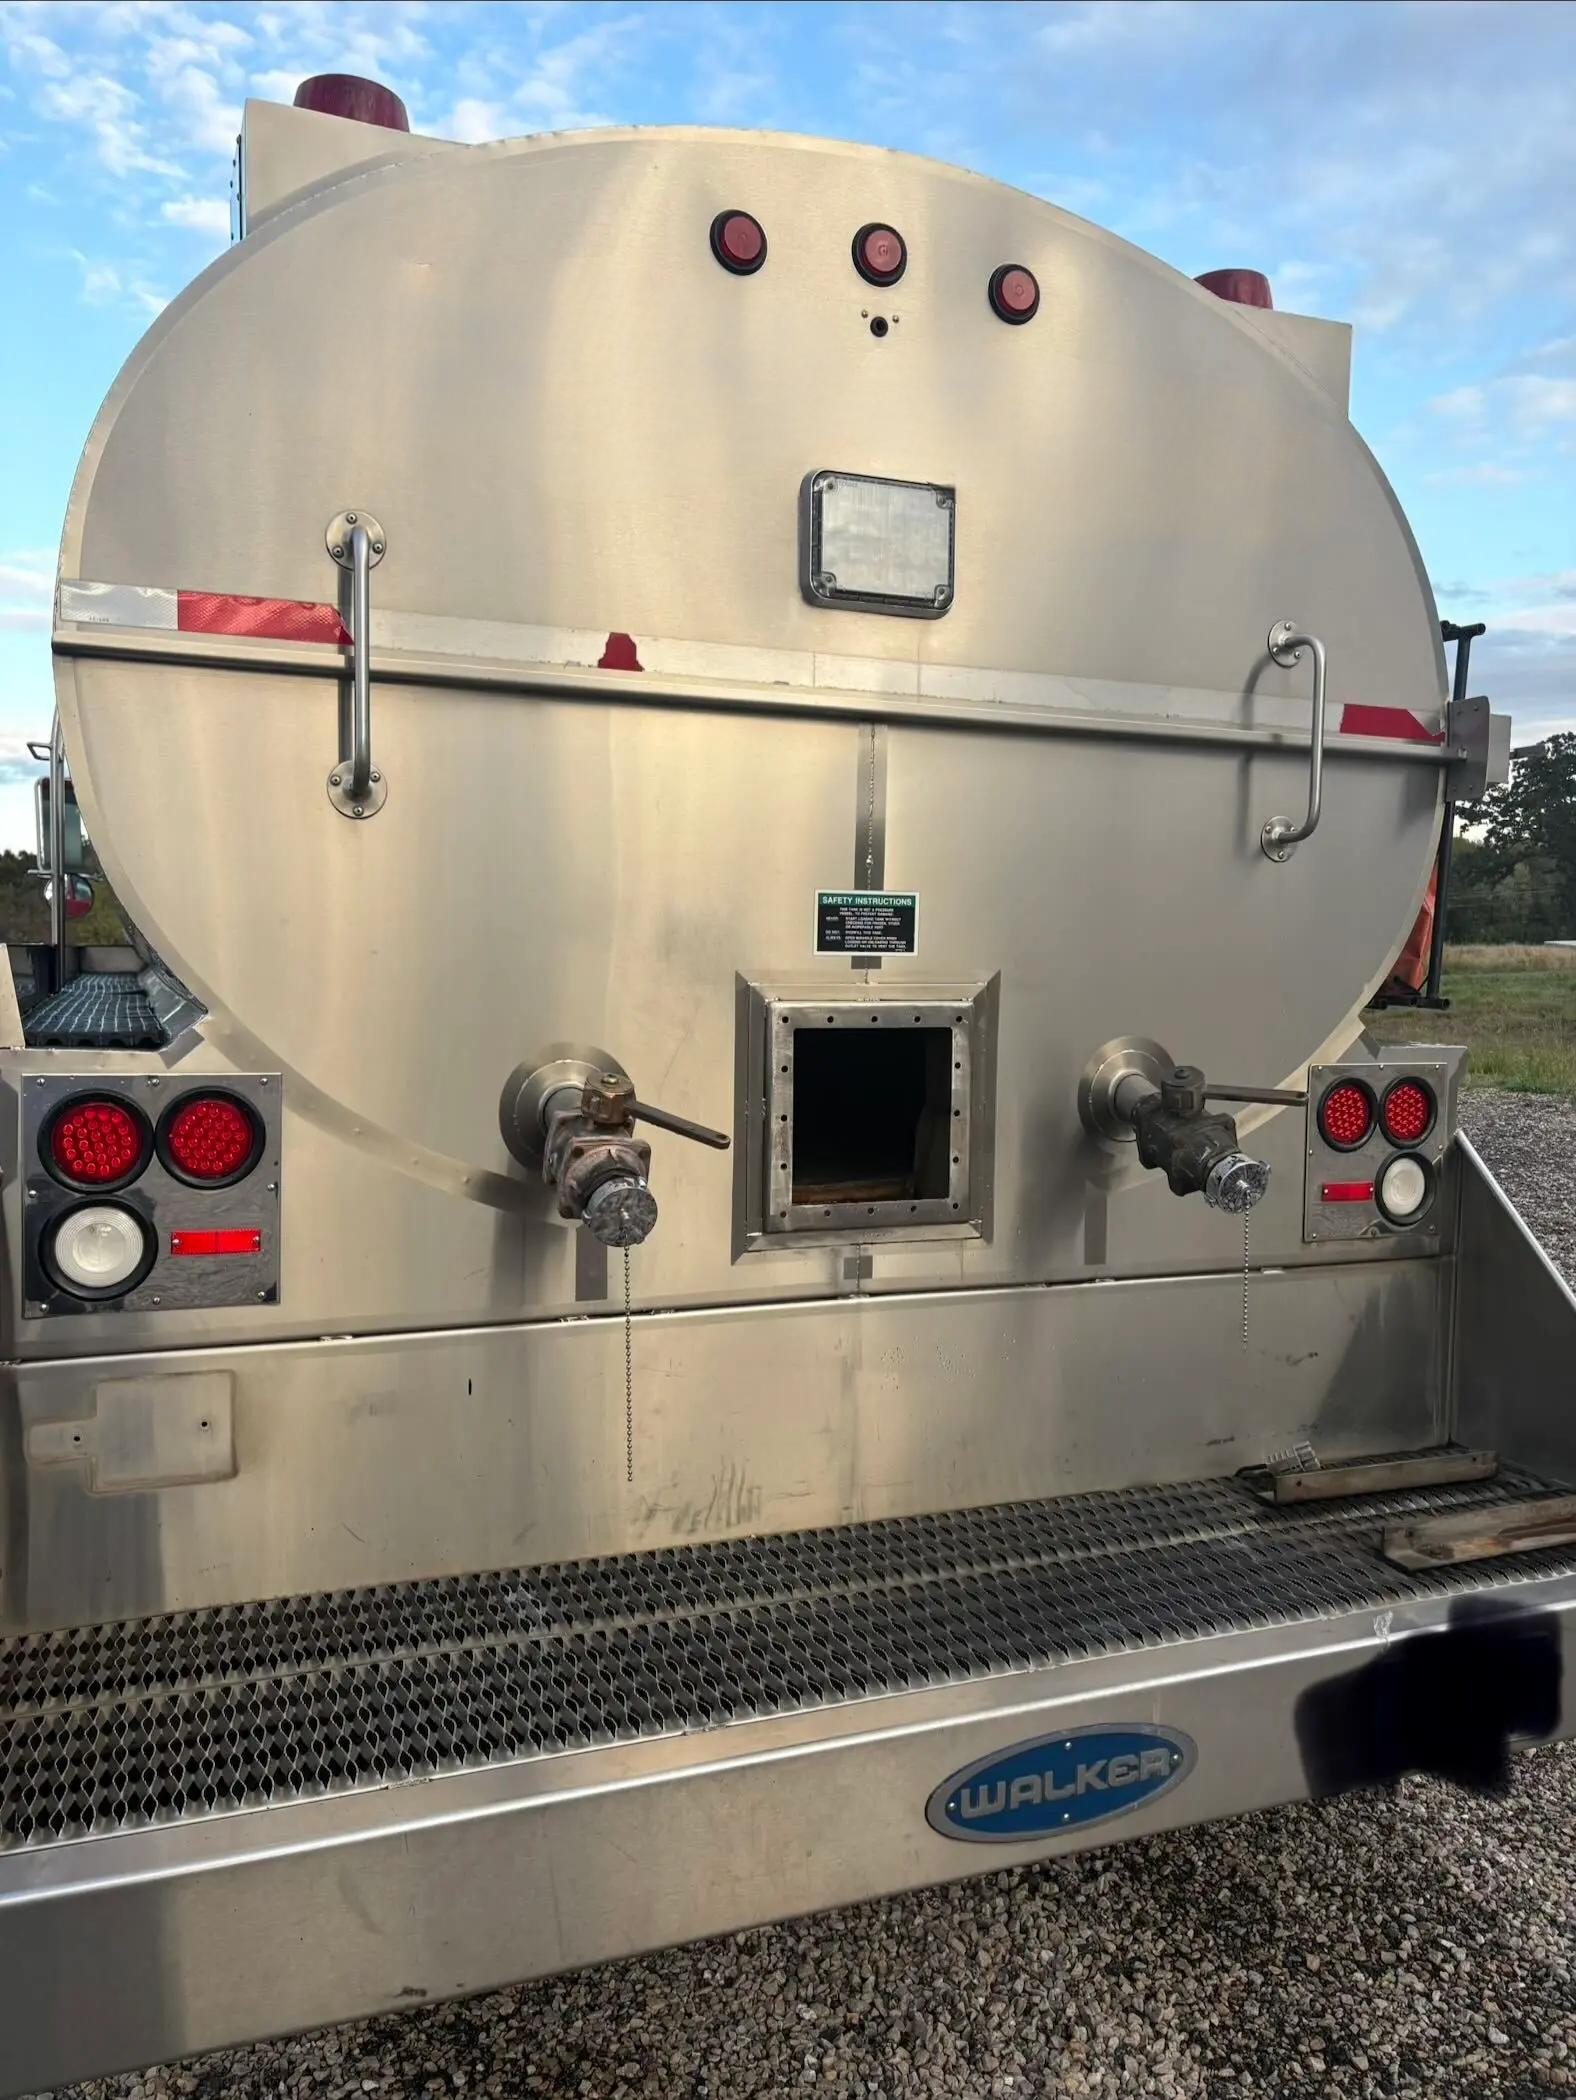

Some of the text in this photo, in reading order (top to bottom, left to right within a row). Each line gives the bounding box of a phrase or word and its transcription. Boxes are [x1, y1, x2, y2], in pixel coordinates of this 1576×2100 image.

[822, 896, 912, 906] SAFETY INSTRUCTIONS
[961, 1747, 1171, 1819] WALKER
